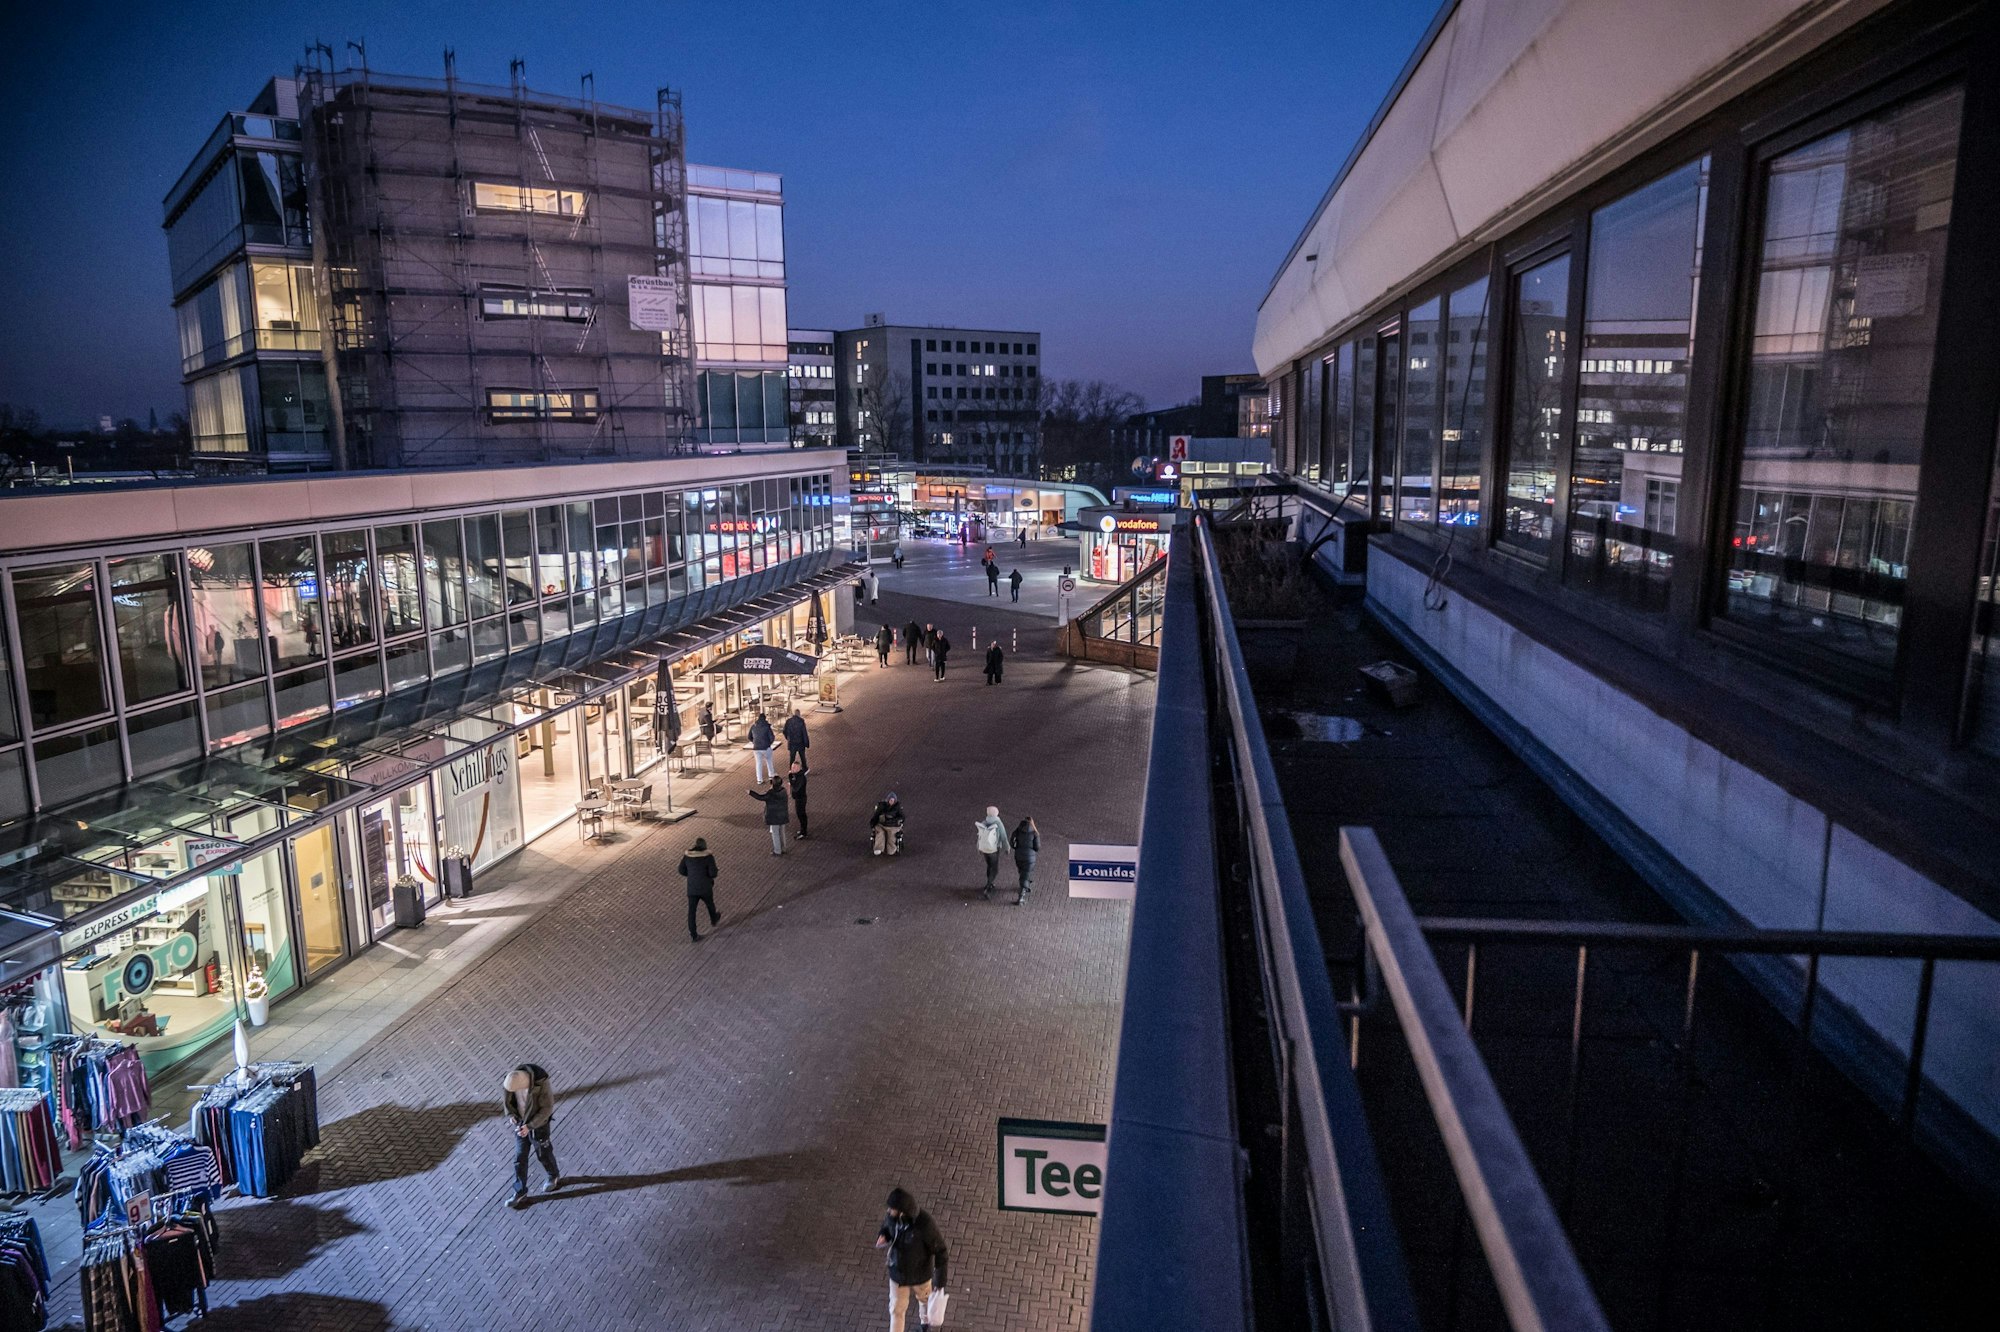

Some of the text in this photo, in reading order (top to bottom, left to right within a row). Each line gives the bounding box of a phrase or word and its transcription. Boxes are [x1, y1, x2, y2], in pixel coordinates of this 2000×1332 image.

[1117, 519, 1158, 530] vodafone
[370, 751, 431, 784] WILLKOMEN
[1078, 864, 1136, 879] Leonidas
[84, 910, 129, 940] EXPRESS
[1014, 1148, 1102, 1199] Tee
[131, 1204, 140, 1223] 9
